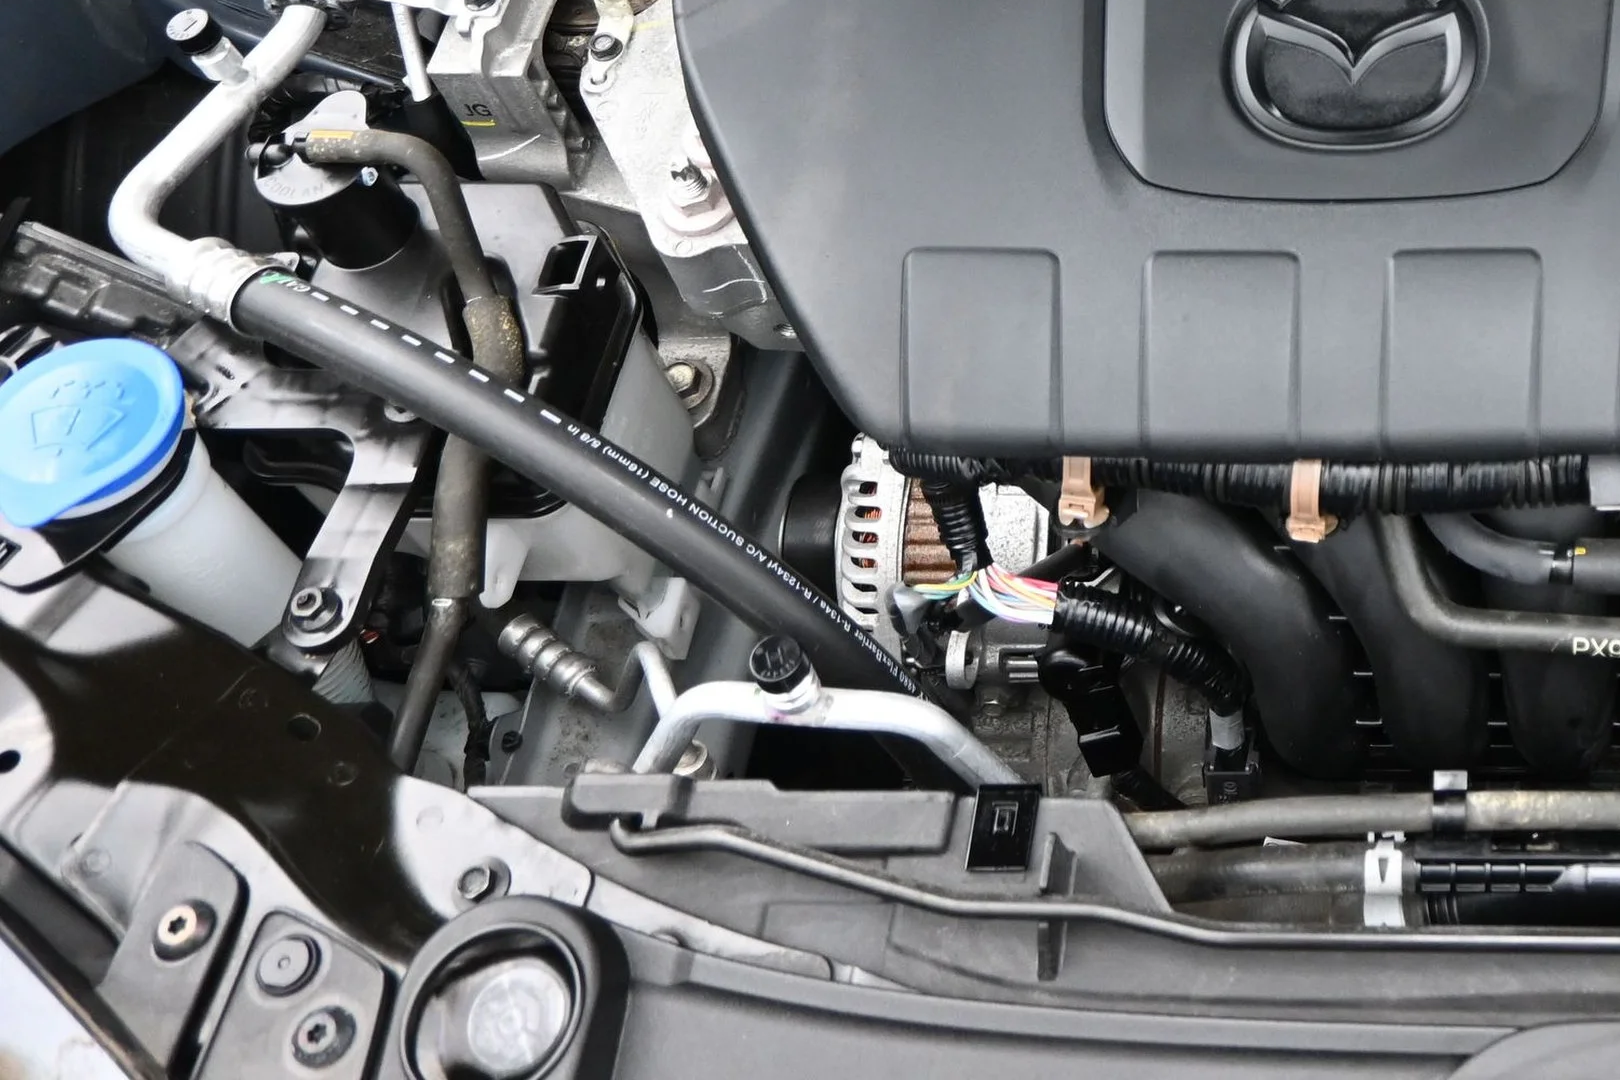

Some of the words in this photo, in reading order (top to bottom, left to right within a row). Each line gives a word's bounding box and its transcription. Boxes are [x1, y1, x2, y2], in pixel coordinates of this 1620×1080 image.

[580, 432, 602, 449] 5/8
[602, 445, 650, 479] (16mm)
[649, 476, 688, 507] HOSE
[688, 503, 745, 547] SUCTION
[746, 543, 767, 562] A/C
[767, 559, 812, 600] R-1234yf
[819, 601, 852, 632] R-134a
[854, 628, 900, 678] FlexBarrier
